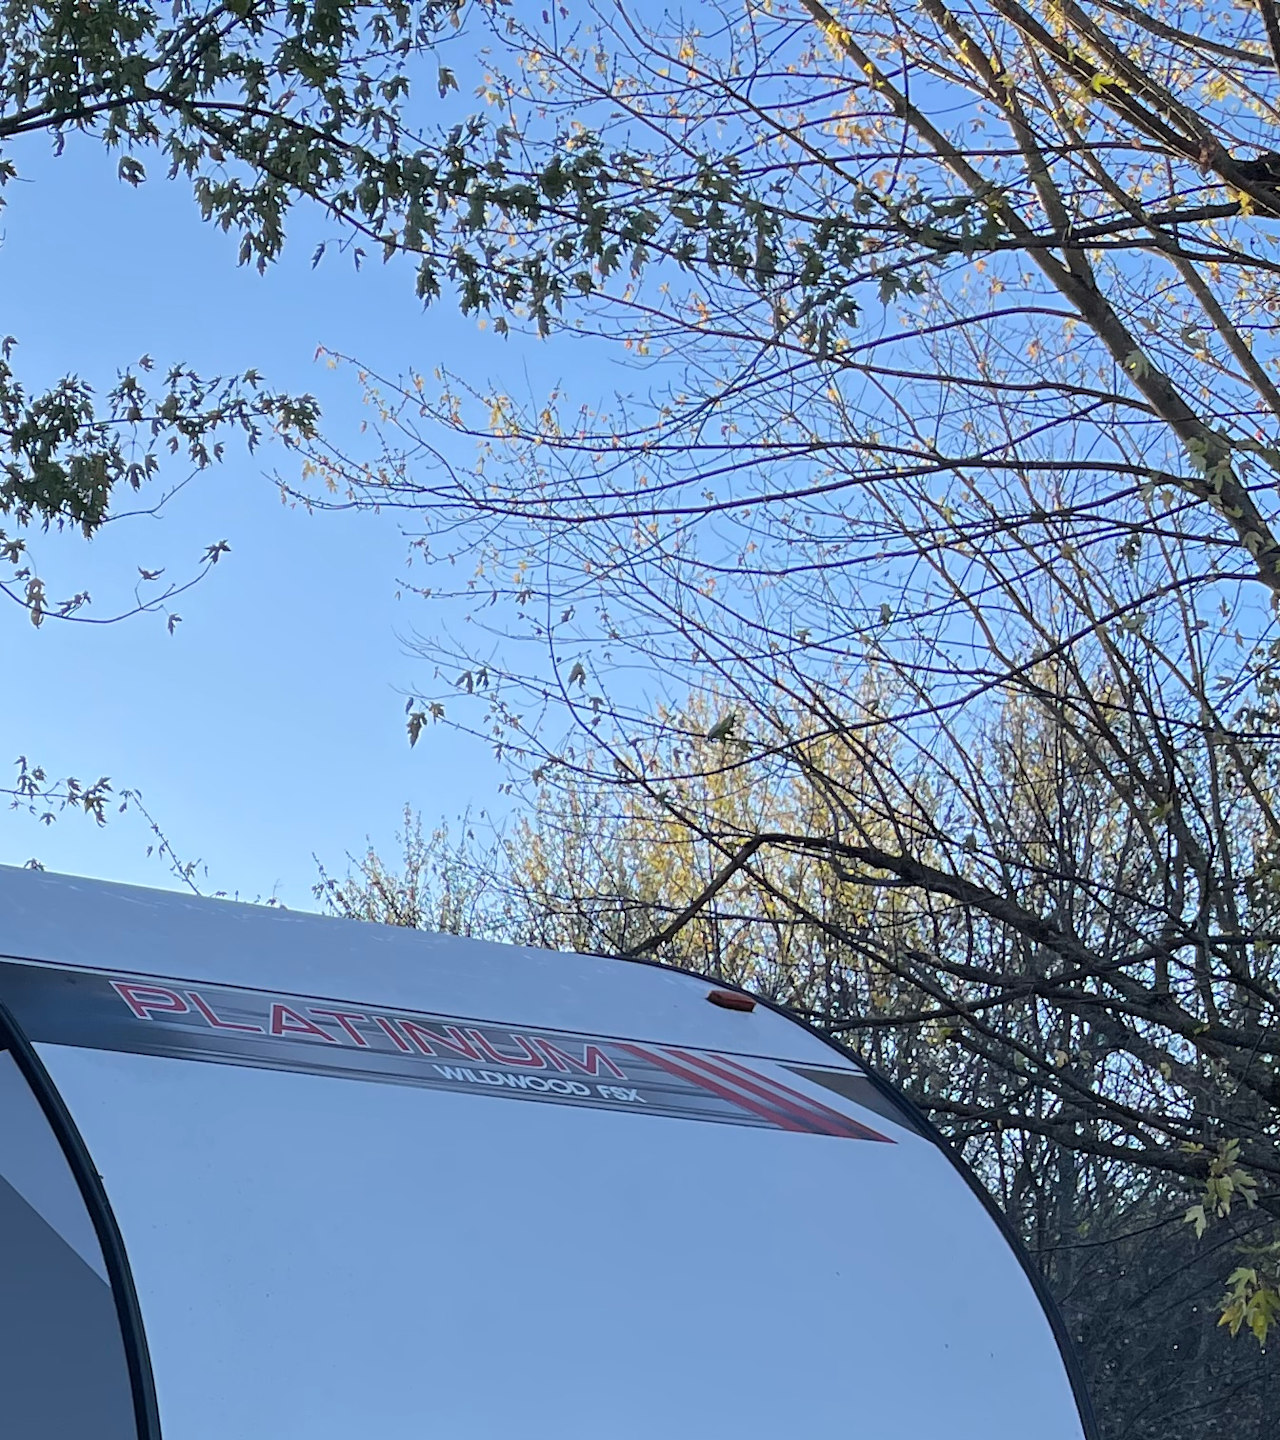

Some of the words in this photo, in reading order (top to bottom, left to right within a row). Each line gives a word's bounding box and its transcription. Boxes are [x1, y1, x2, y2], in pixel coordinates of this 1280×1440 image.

[108, 980, 629, 1080] PLATINUM
[432, 1063, 591, 1098] WILDWOOD
[595, 1082, 648, 1105] FSX
